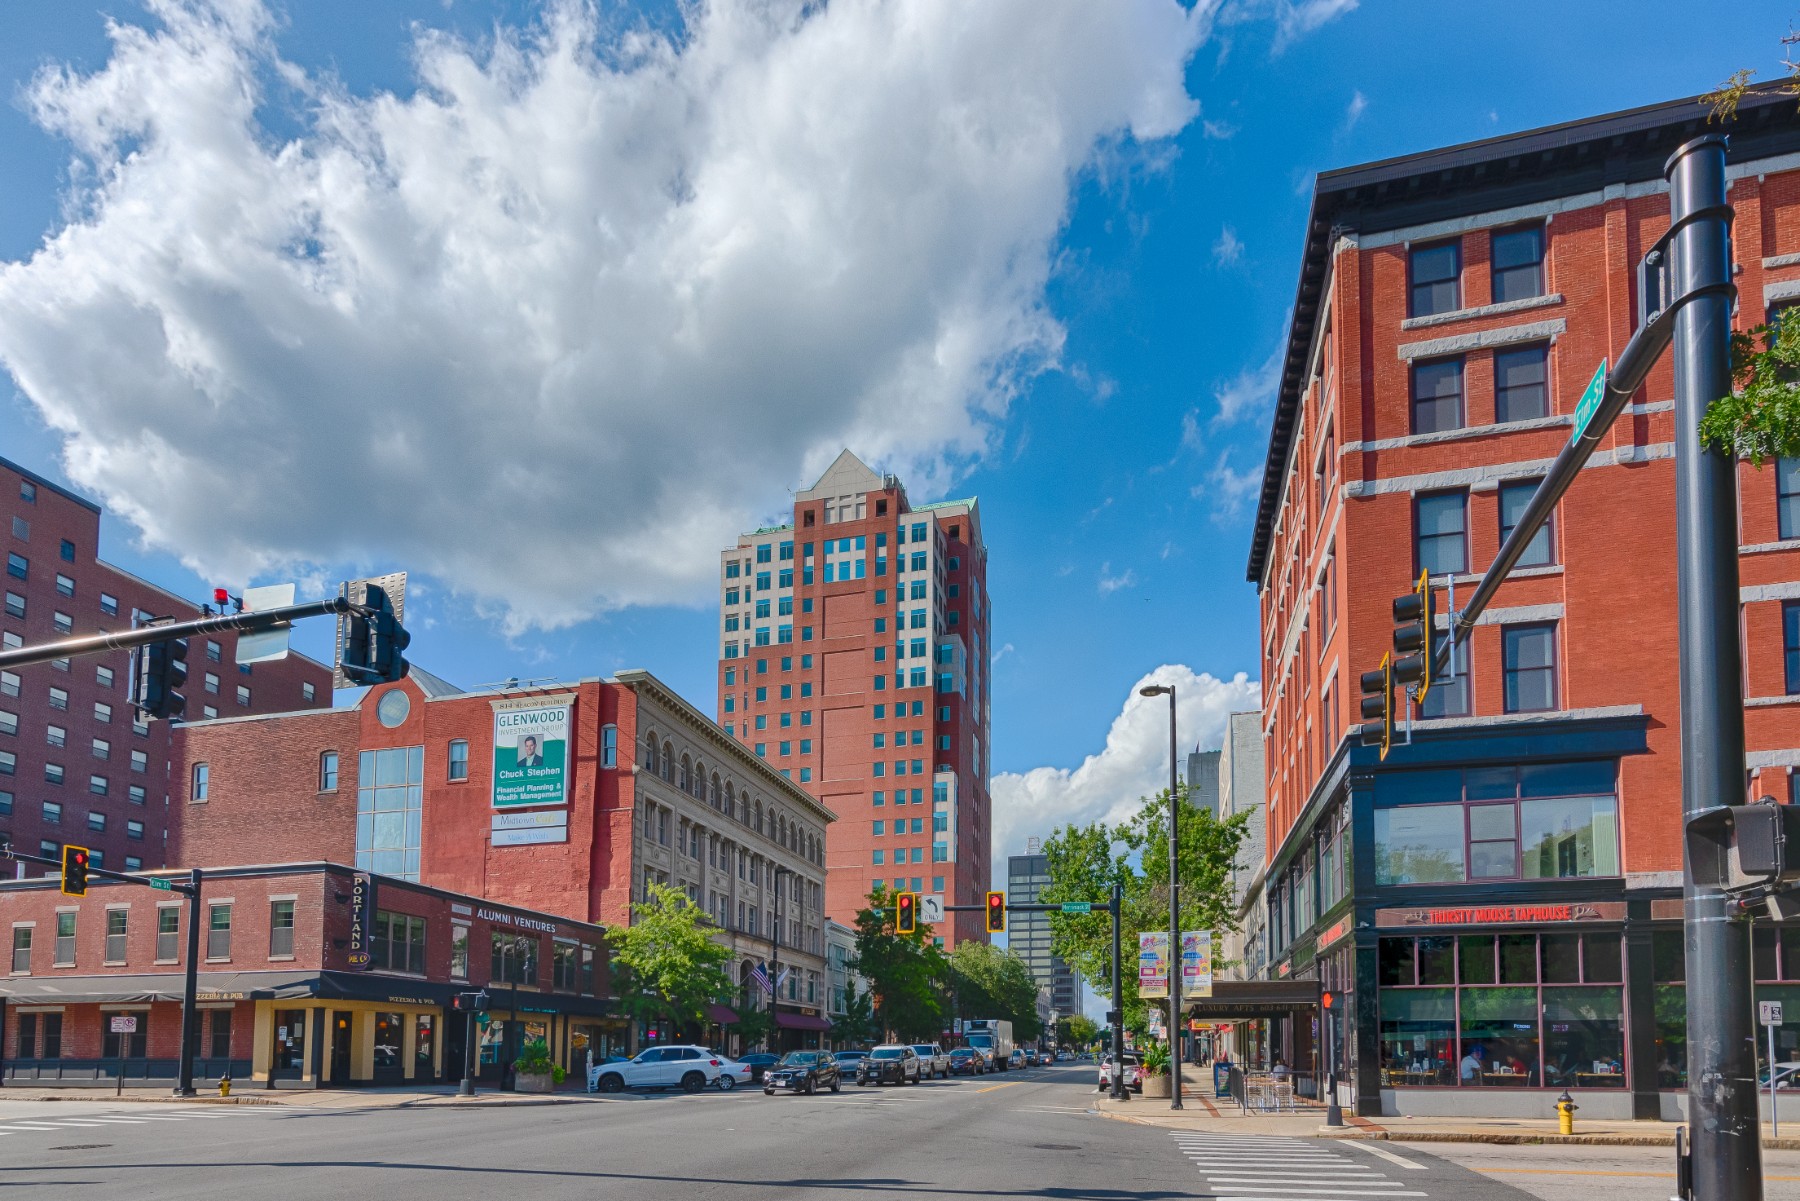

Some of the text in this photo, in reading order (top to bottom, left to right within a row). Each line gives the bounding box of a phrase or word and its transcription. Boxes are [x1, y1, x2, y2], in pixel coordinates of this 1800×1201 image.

[1575, 374, 1604, 434] Elm St
[499, 711, 565, 727] GLENWOOD
[499, 724, 564, 736] INVESTMENT GROUP
[499, 767, 560, 778] Chuck Stephen
[496, 785, 525, 794] Financial
[526, 784, 554, 792] Planning
[520, 791, 562, 800] Management
[500, 815, 535, 826] Midtown
[352, 877, 362, 950] PORTLAND
[477, 908, 511, 924] ALUMNI
[514, 916, 556, 932] VENTURES
[1430, 906, 1571, 923] THIRSTY MOOSE TAPHOUSE
